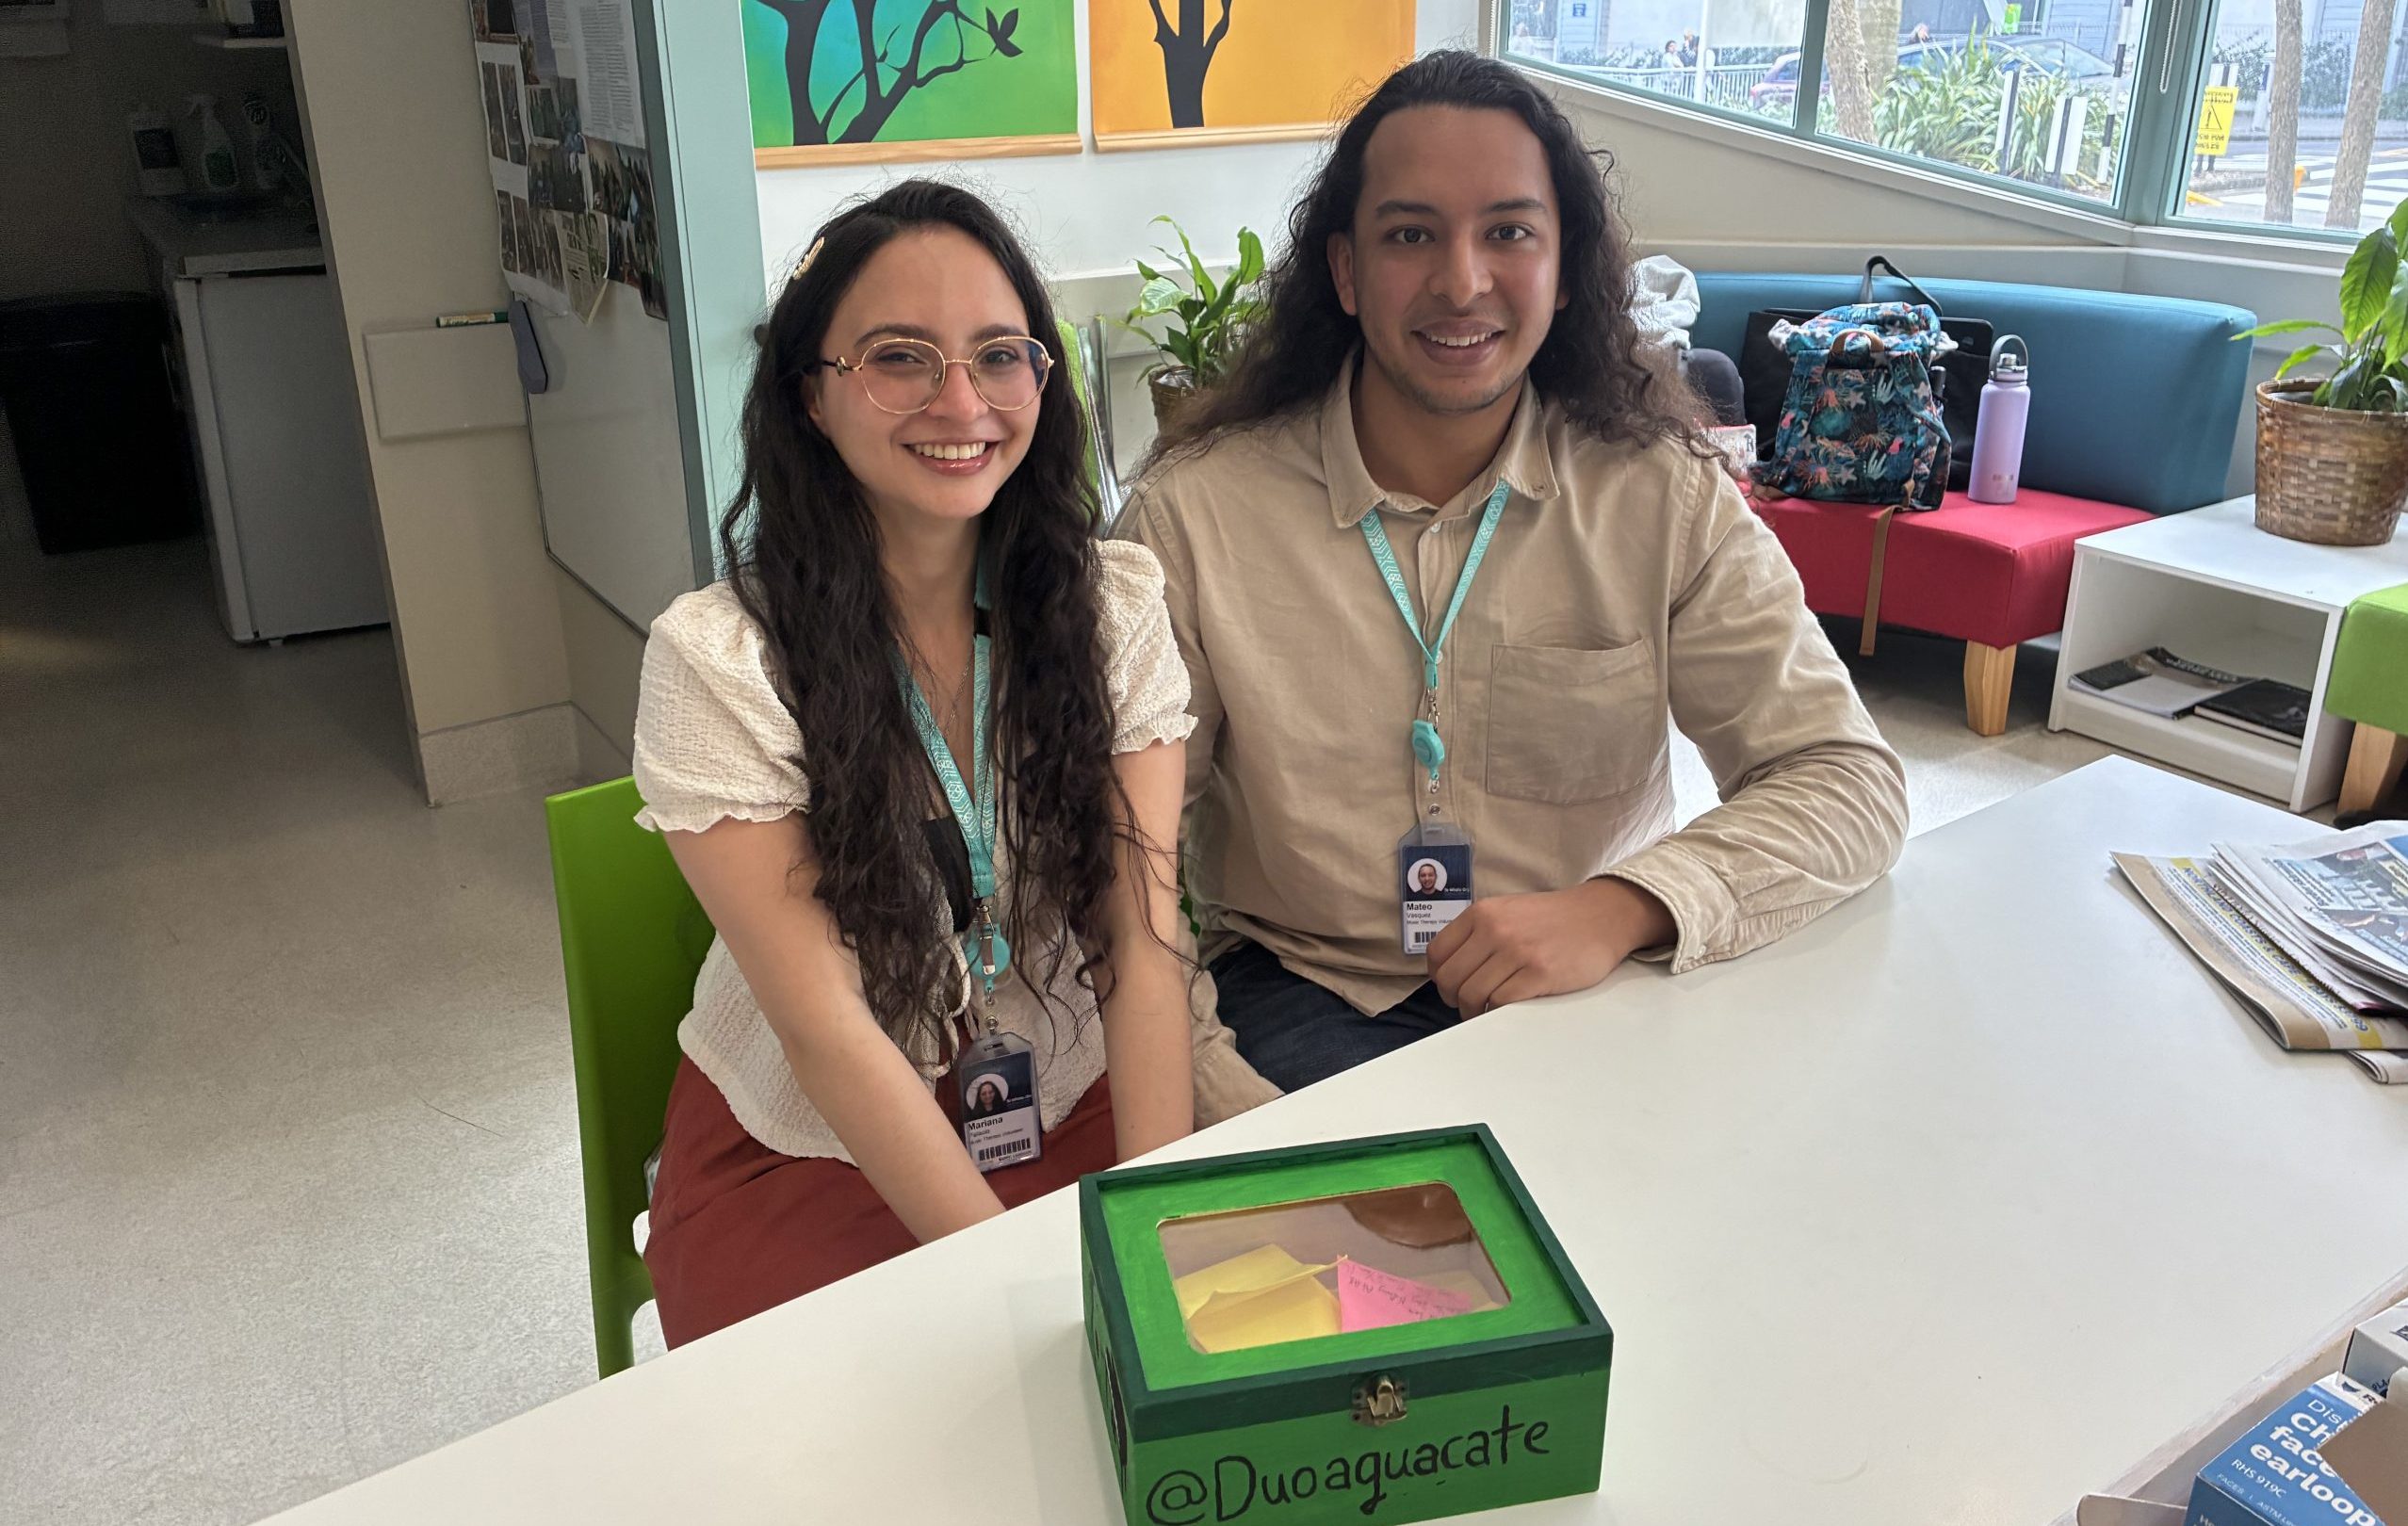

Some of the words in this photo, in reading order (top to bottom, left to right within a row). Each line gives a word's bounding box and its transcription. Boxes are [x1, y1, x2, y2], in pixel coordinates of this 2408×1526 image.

[1407, 902, 1432, 911] Mateo
[968, 1117, 1003, 1130] Mariana
[1146, 1404, 1551, 1526] @Duoaguacate
[2231, 1458, 2257, 1479] RHS
[2256, 1475, 2286, 1499] 919C
[2250, 1443, 2376, 1526] earloop
